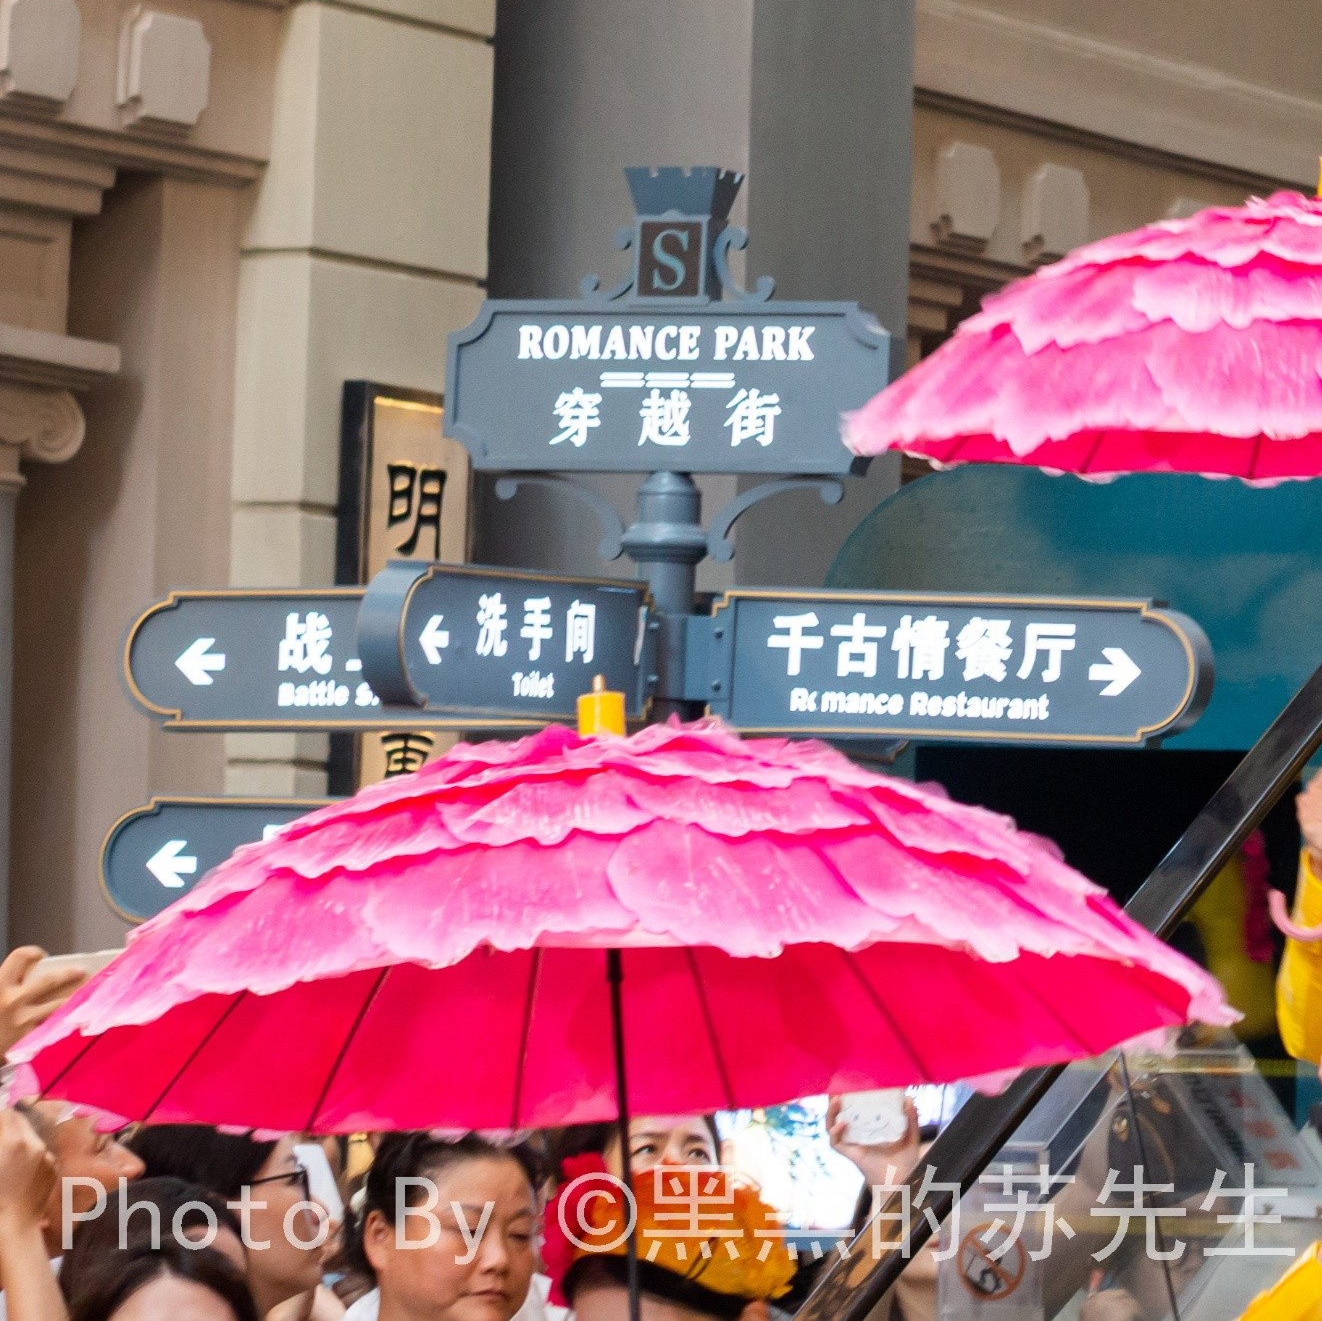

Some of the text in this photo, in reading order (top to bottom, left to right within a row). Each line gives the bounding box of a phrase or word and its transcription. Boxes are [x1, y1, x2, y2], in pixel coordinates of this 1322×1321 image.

[651, 228, 690, 292] S
[516, 324, 816, 361] ROMANCE PARK
[548, 386, 783, 448] 穿越街
[475, 592, 597, 664] 洗手间
[767, 611, 1077, 683] 千古情餐厅
[277, 679, 380, 707] Battle S
[511, 670, 556, 700] Toilet
[909, 690, 1050, 721] Restaurant
